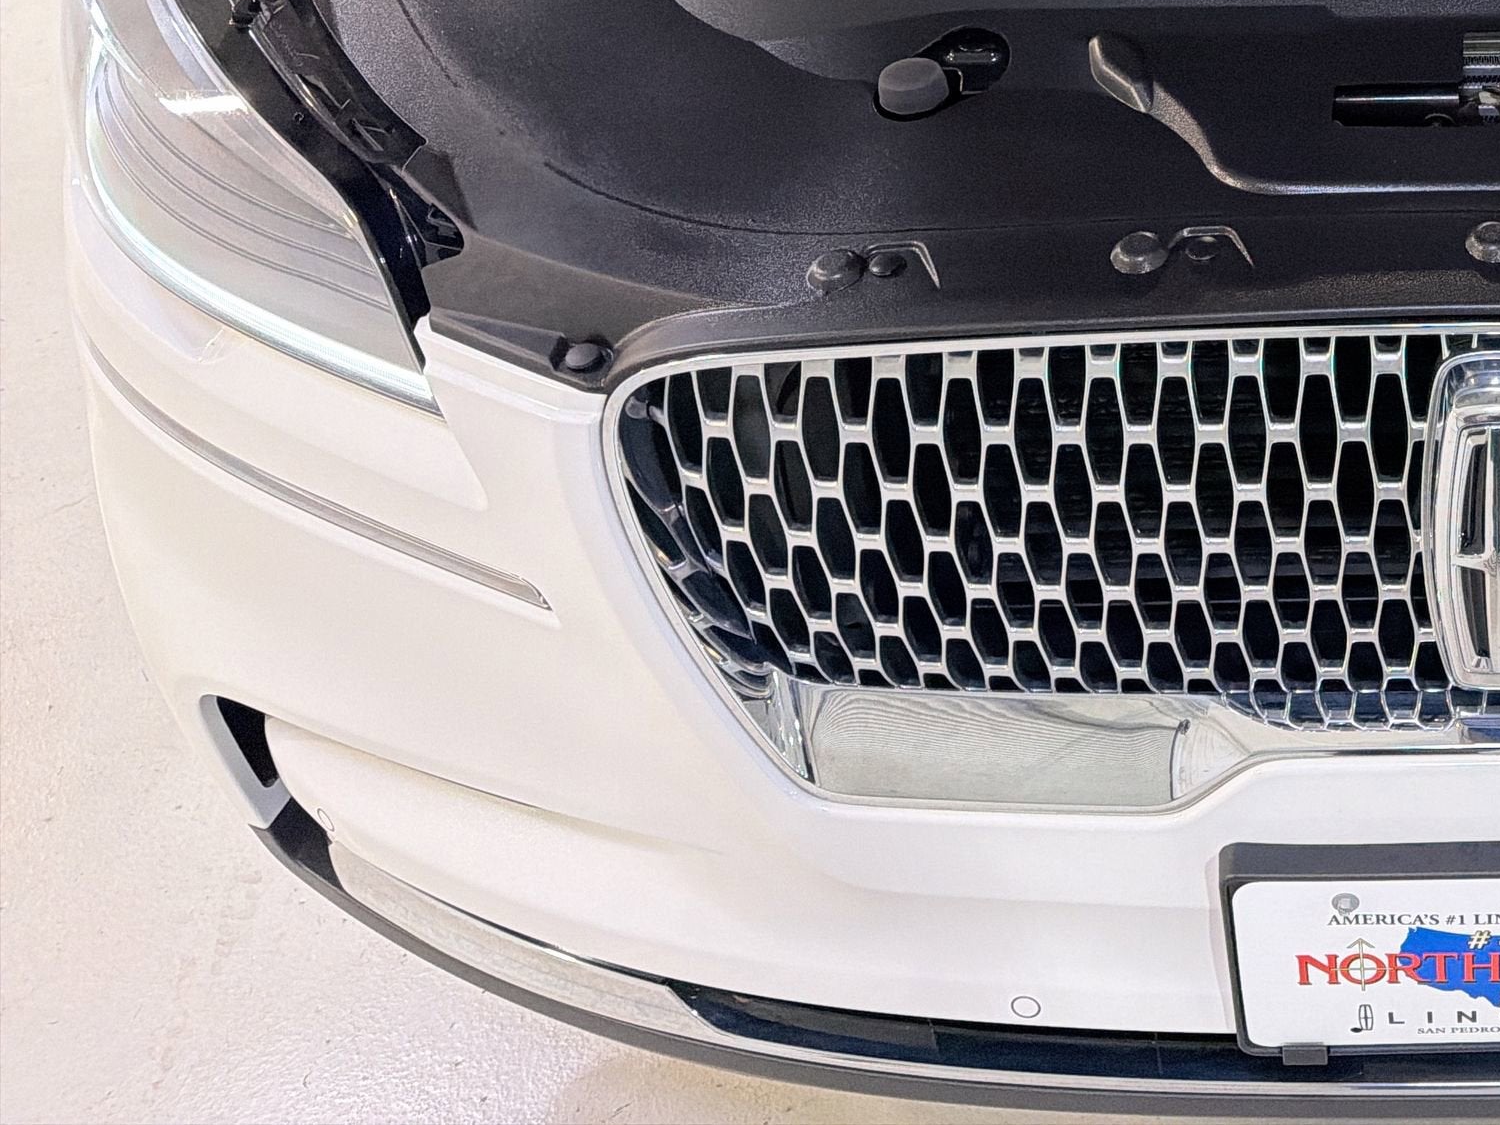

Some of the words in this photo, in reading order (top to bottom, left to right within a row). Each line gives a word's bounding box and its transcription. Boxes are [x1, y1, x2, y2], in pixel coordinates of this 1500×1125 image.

[1327, 913, 1440, 926] AMERICA'S
[1445, 914, 1466, 926] #1
[1416, 1026, 1446, 1035] SAN
